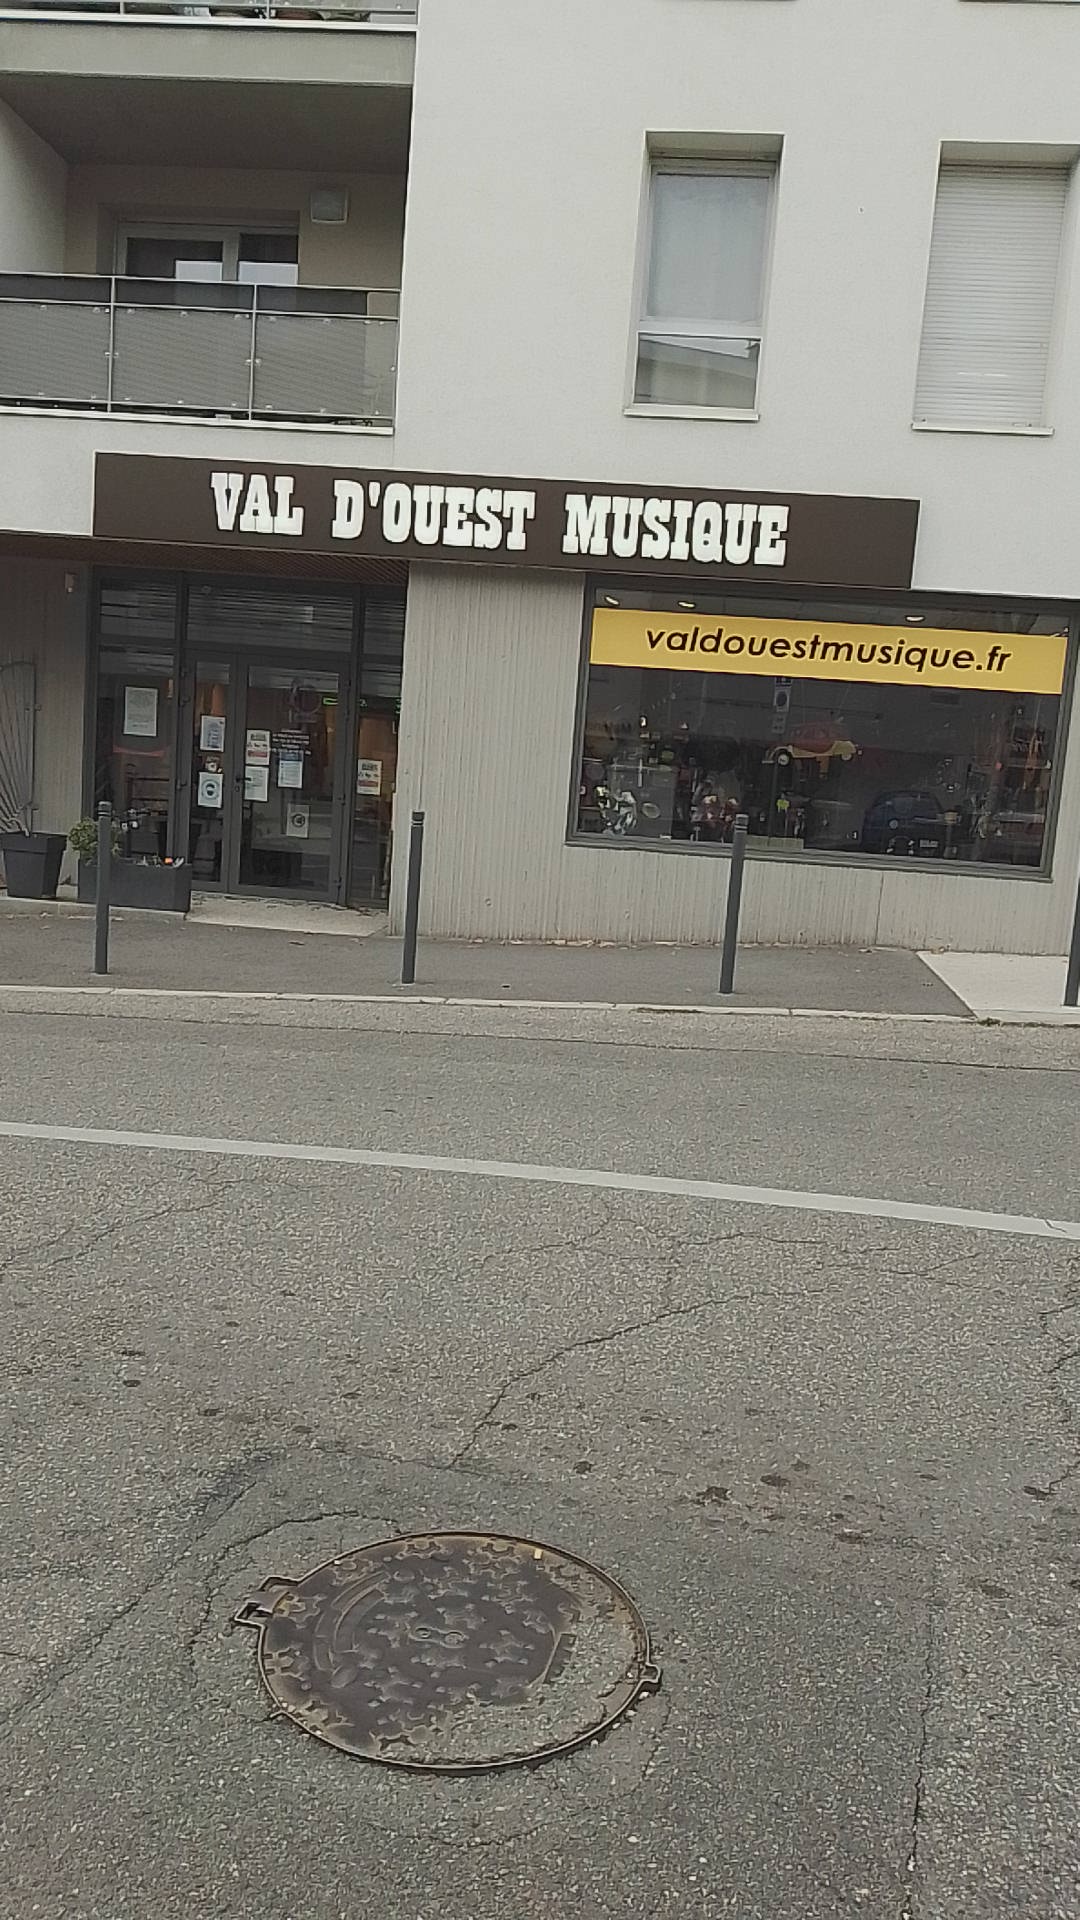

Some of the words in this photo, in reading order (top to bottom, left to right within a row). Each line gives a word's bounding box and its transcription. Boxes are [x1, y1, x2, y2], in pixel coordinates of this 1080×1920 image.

[210, 472, 304, 536] VAL
[331, 479, 536, 550] D'OUEST
[562, 493, 790, 566] MUSIQUE
[646, 627, 1012, 673] valdouestmusique.fr
